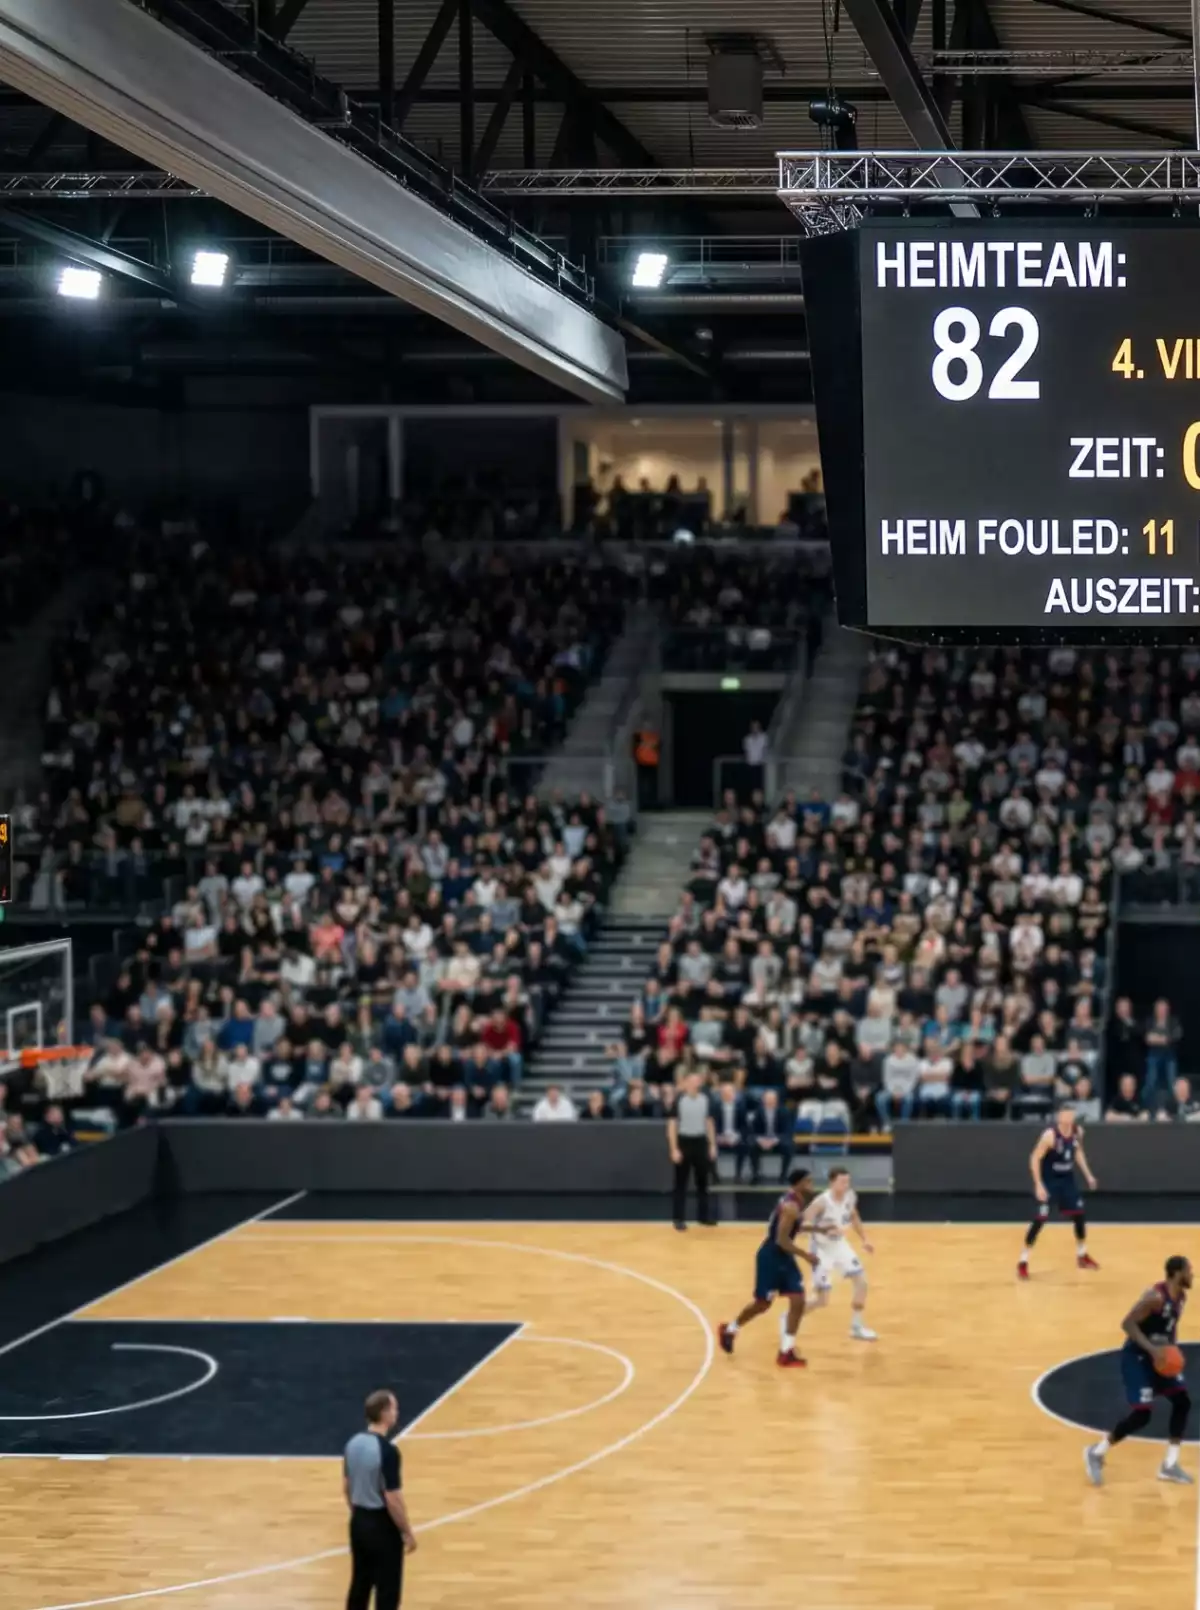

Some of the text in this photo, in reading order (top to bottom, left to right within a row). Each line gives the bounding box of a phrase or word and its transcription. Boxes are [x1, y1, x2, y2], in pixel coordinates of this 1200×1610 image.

[876, 241, 1127, 288] HEIMTEAM:
[931, 306, 1041, 402] 82
[1111, 338, 1144, 380] 4.
[1068, 437, 1165, 479] ZEIT:
[881, 519, 967, 555] HEIM
[977, 518, 1129, 556] FOULED:
[1142, 519, 1176, 556] 11
[1044, 577, 1200, 614] AUSZEIT:
